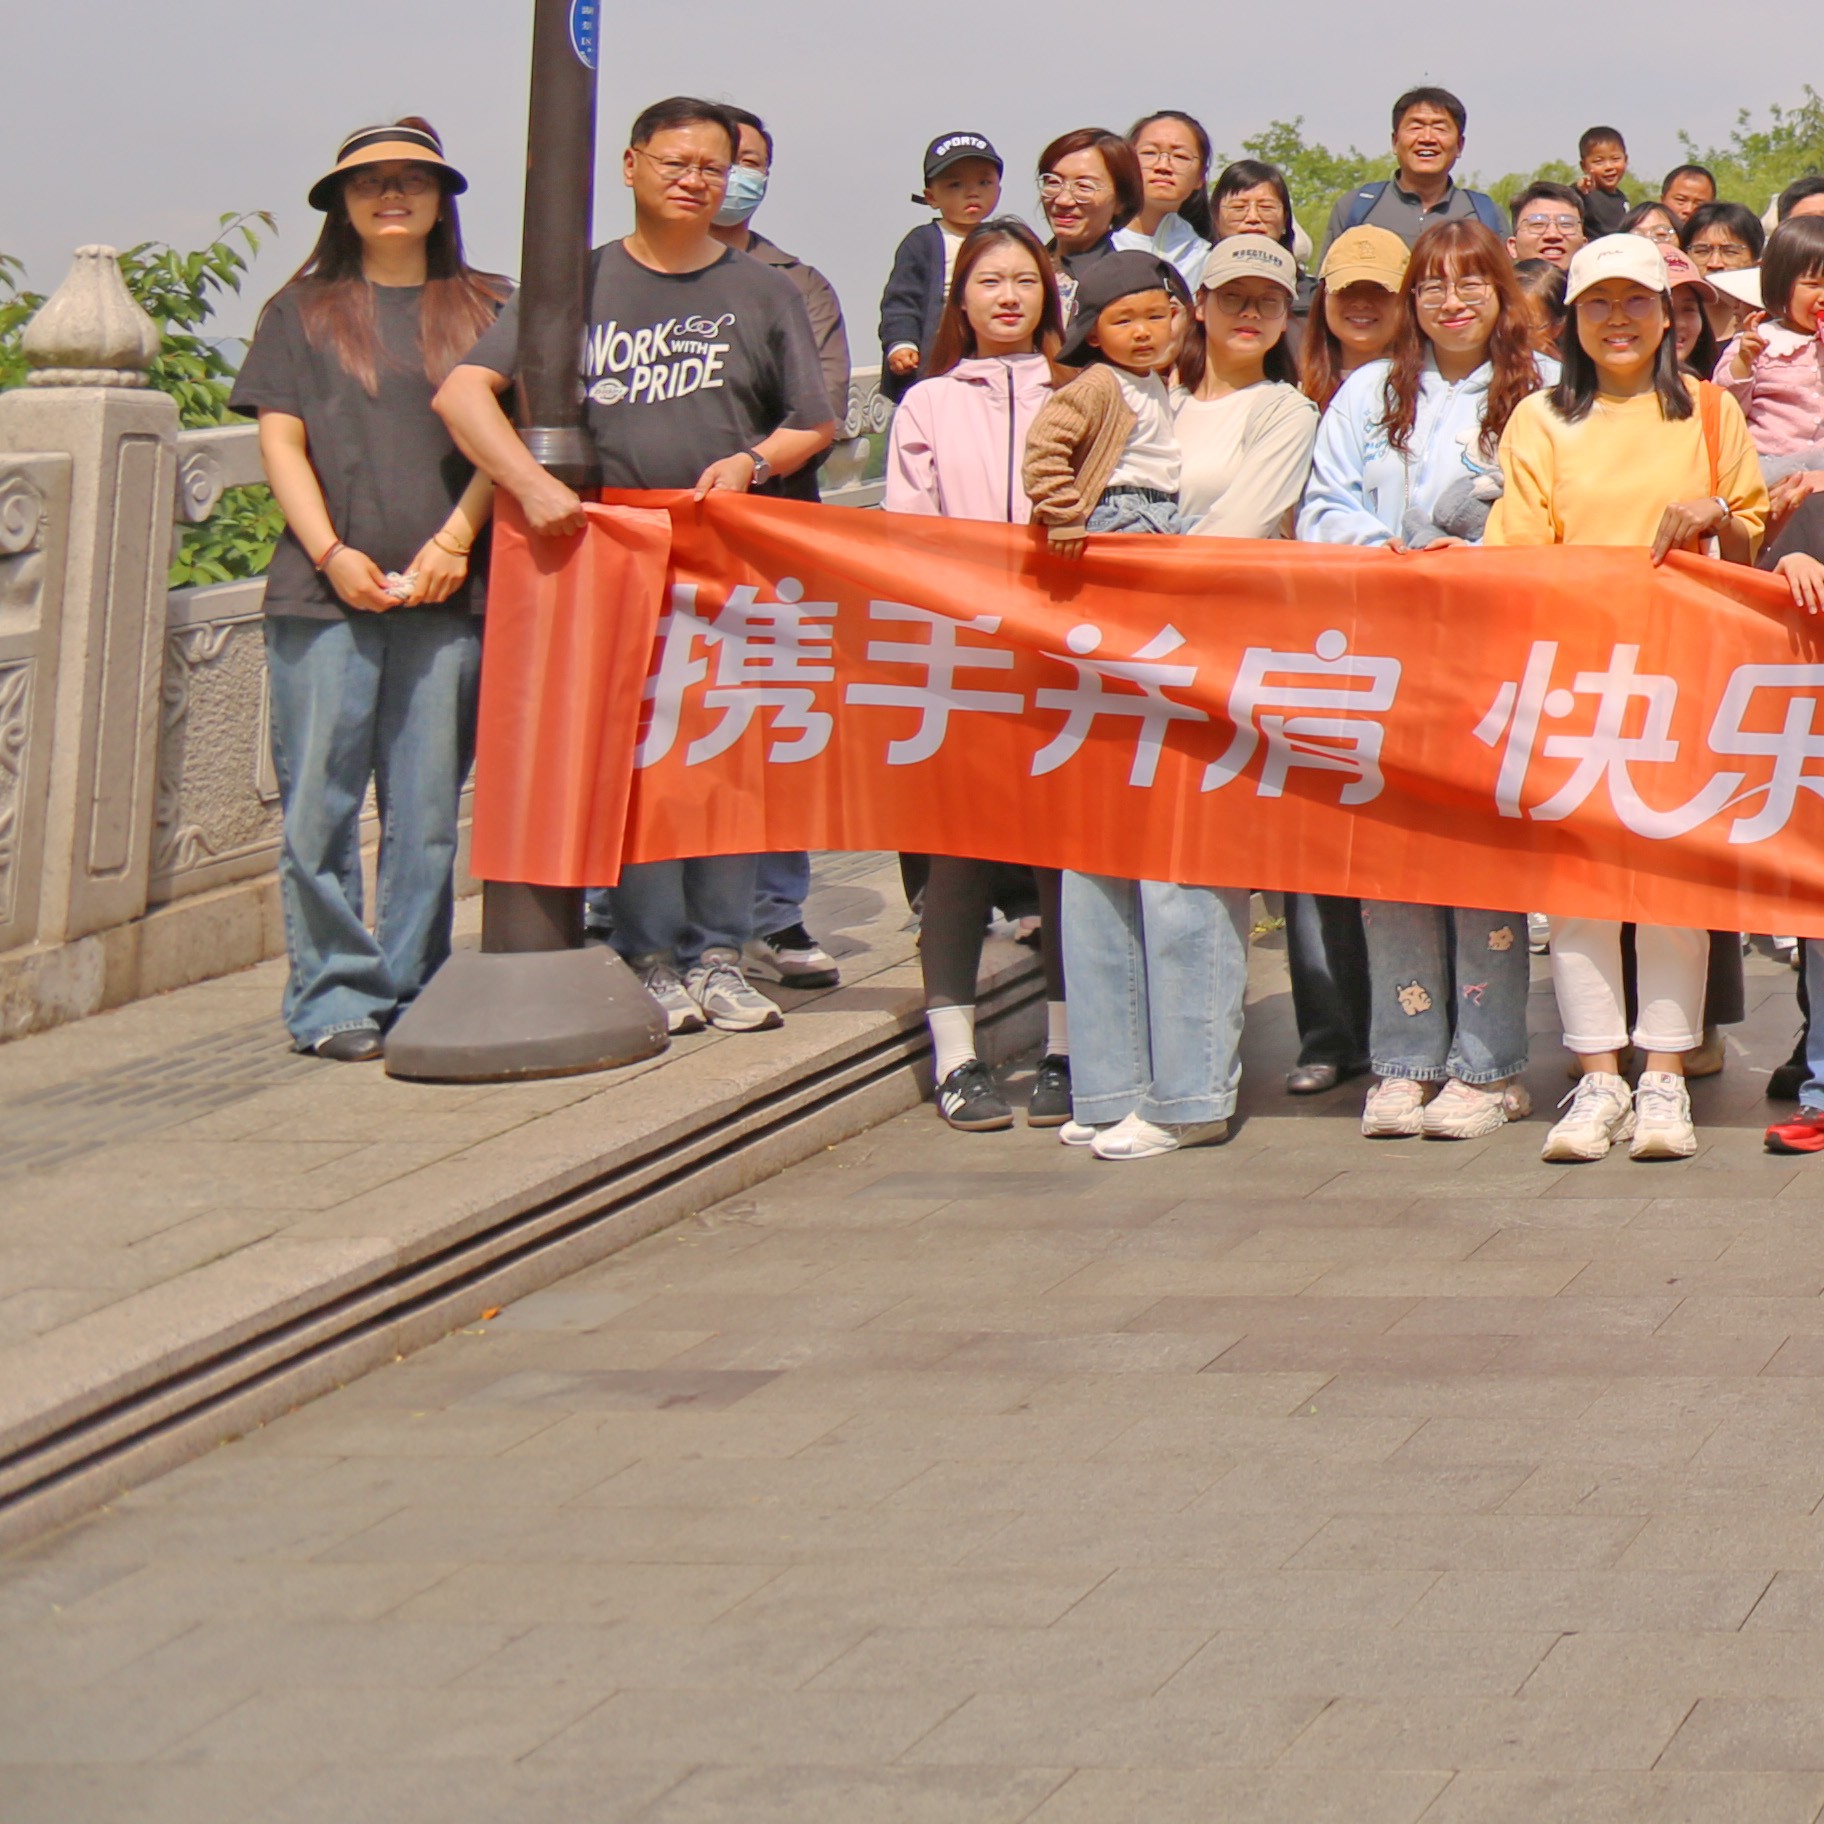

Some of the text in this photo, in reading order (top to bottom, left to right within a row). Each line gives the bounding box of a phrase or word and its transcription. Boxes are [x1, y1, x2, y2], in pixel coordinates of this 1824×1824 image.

[936, 136, 987, 156] SPORTS
[585, 319, 708, 376] WORK WITH
[629, 343, 730, 404] PRIDE
[634, 577, 1402, 805] 携手并肩
